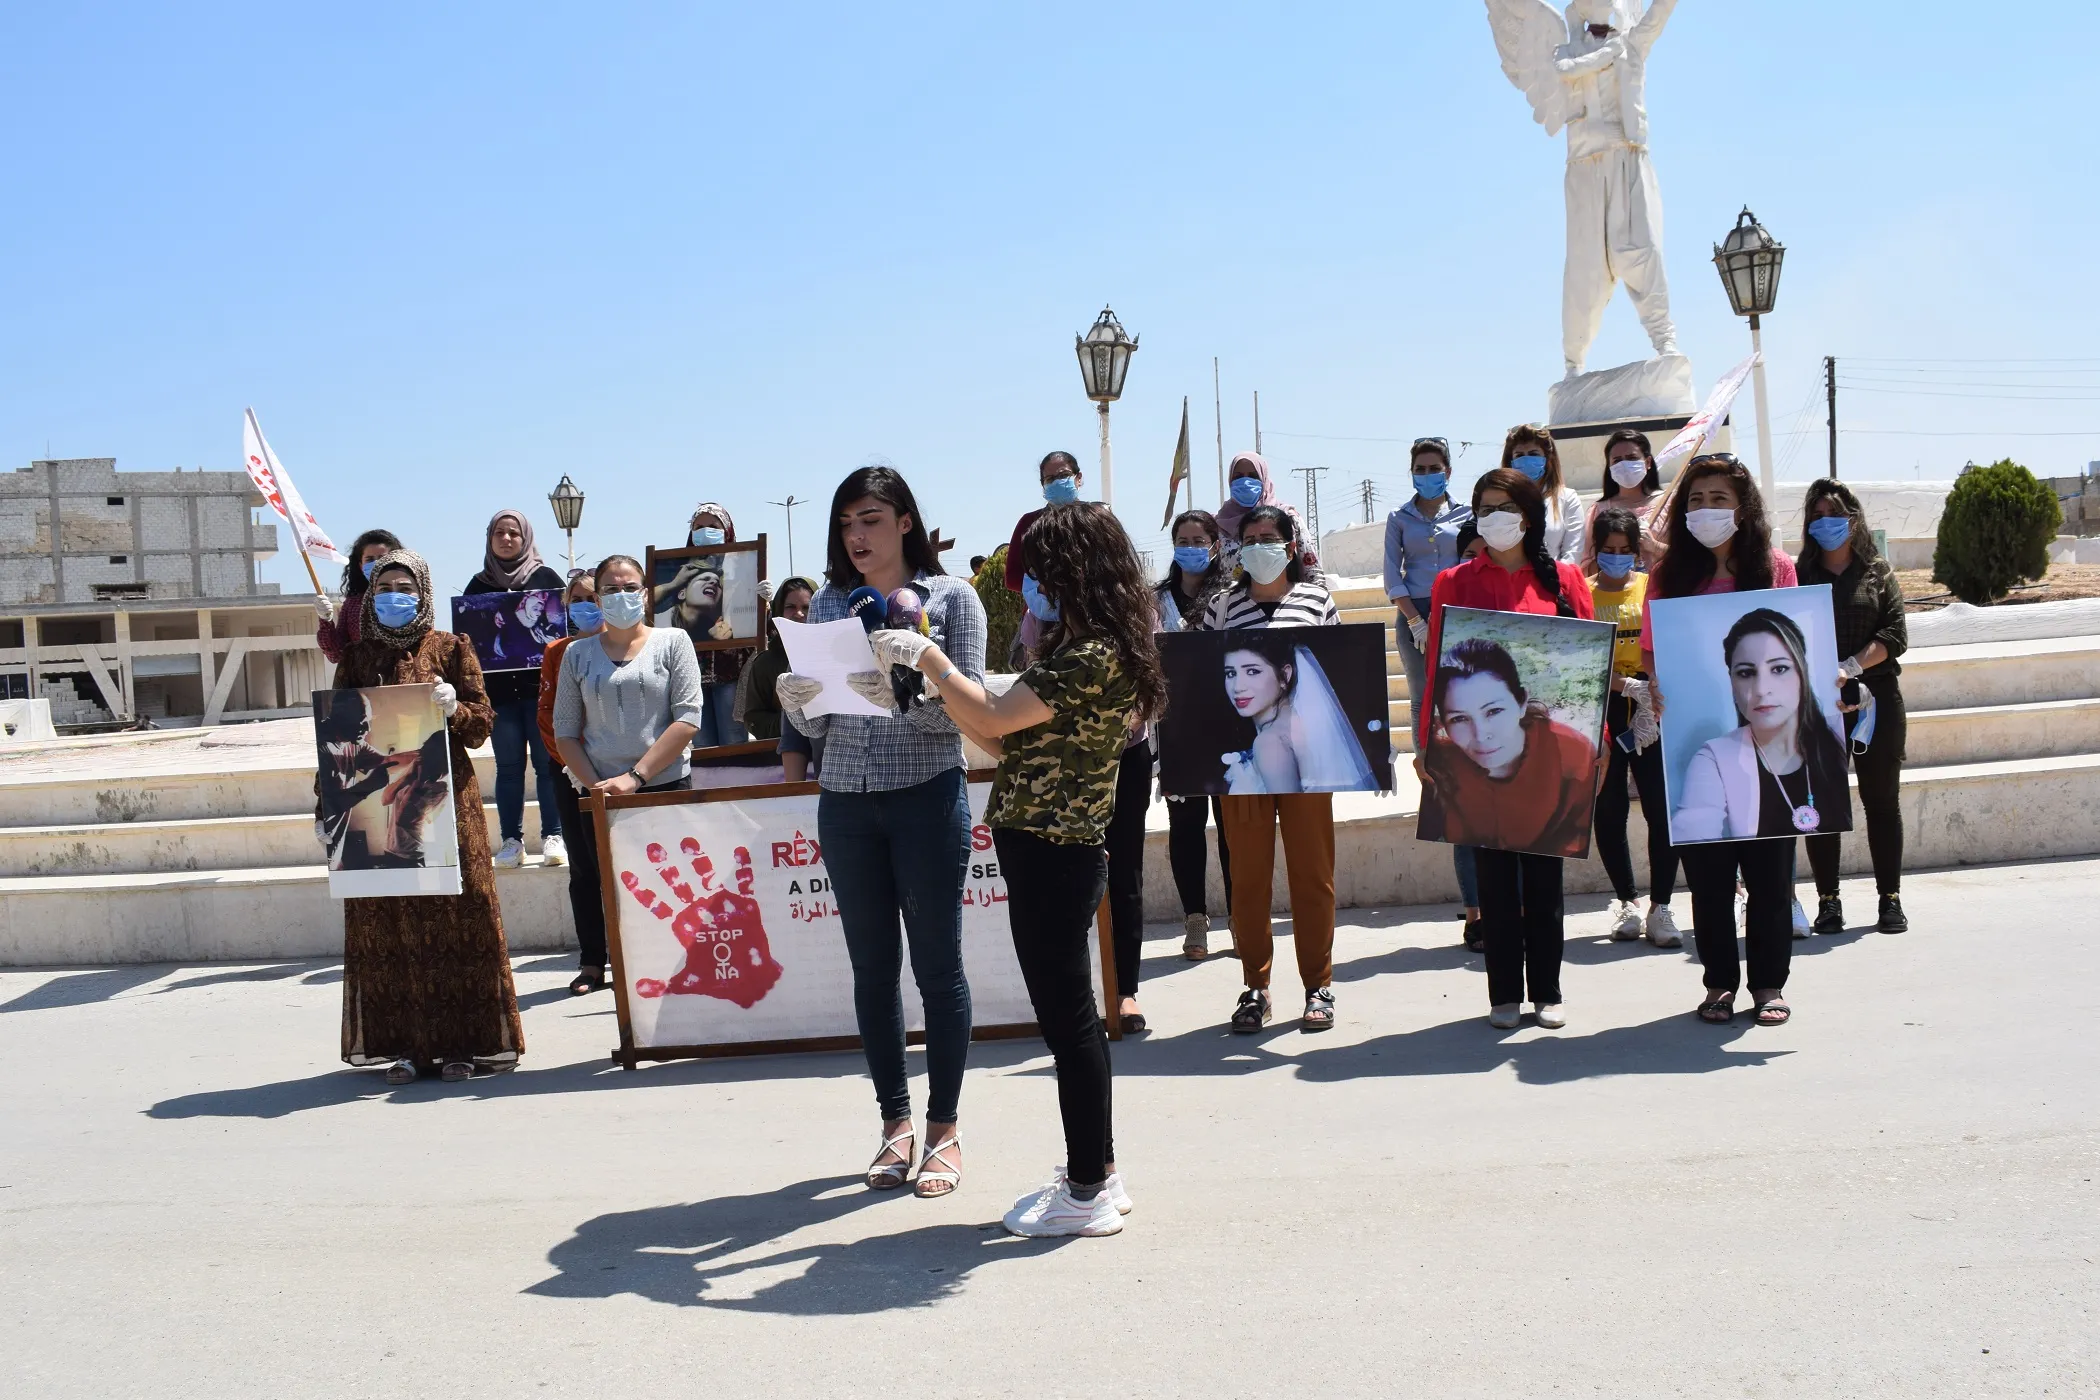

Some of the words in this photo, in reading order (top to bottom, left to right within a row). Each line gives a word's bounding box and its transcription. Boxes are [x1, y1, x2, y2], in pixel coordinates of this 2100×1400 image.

[788, 880, 803, 895] A
[695, 929, 743, 943] STOP
[715, 966, 740, 980] NA
